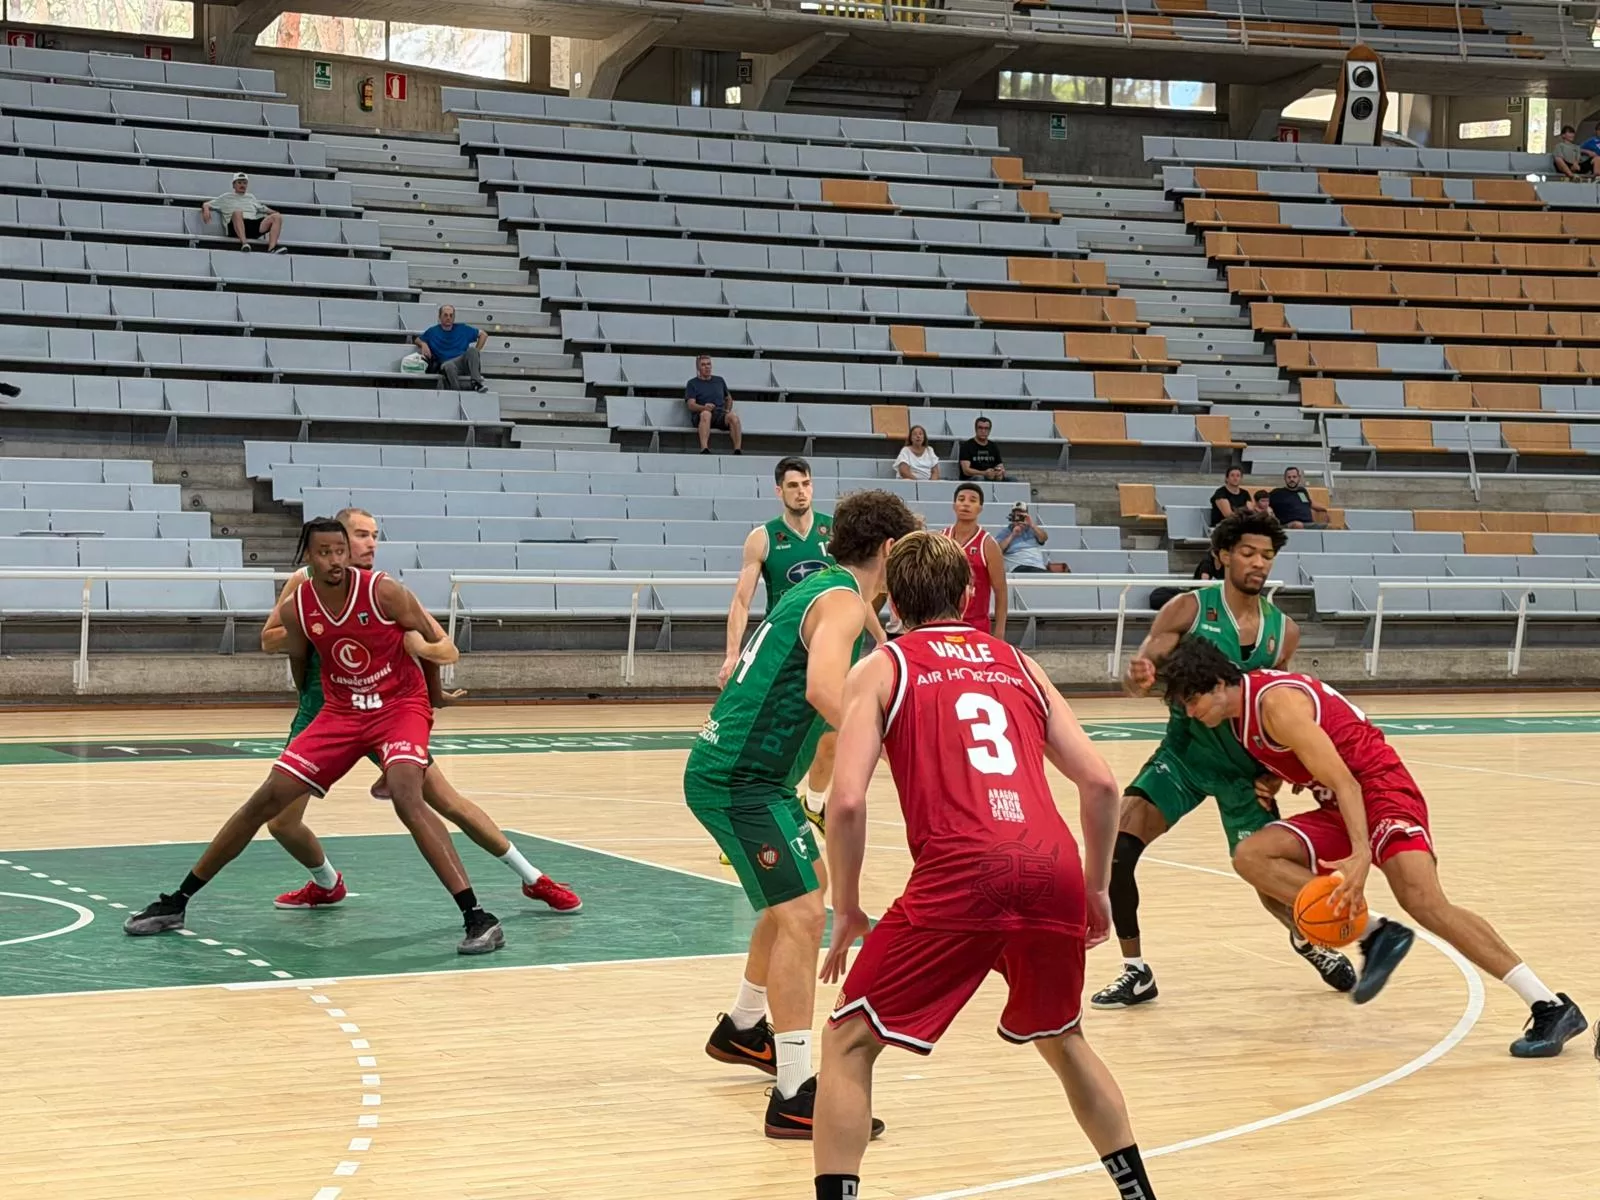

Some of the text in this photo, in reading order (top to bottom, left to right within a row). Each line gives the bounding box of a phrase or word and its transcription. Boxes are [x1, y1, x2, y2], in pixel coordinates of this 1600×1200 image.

[927, 640, 995, 663] VALLE
[917, 670, 943, 686] AIR
[955, 692, 1017, 776] 3
[989, 799, 1021, 812] SABOR
